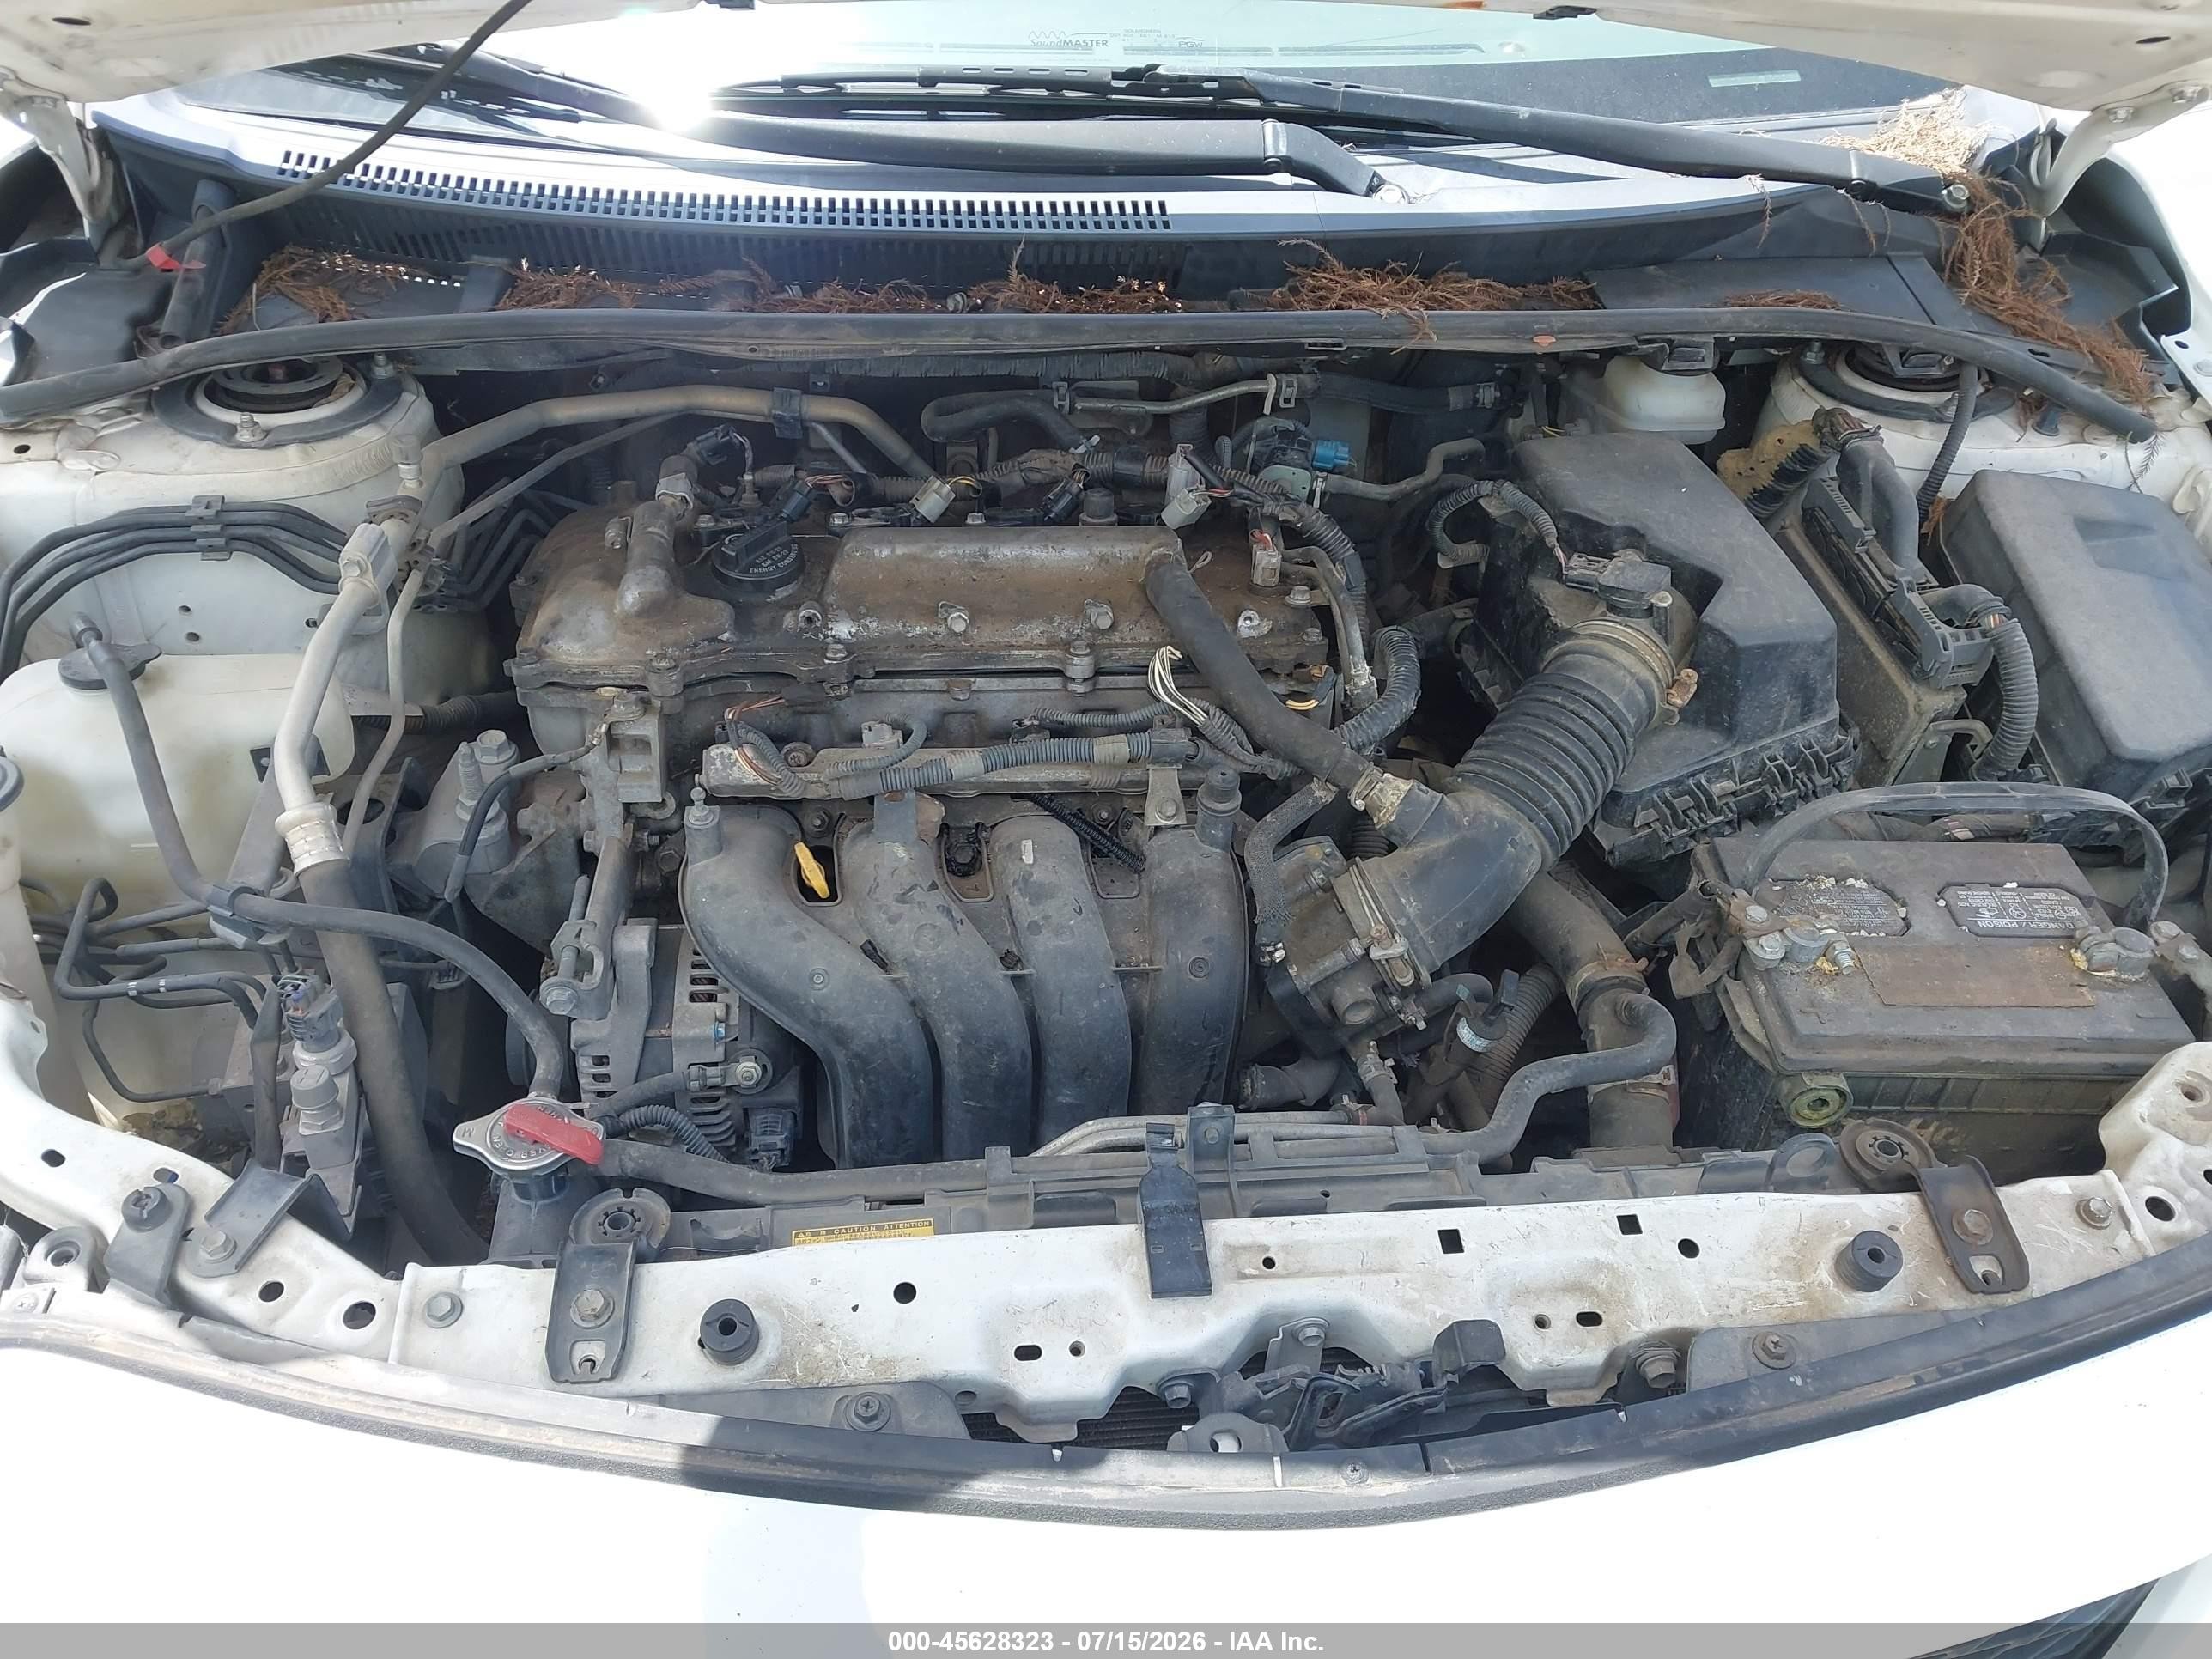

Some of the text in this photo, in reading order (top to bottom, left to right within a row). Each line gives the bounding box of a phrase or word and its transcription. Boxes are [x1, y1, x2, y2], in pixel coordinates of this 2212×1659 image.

[749, 565, 776, 574] ENERGY
[1978, 920, 2020, 928] POISON
[2030, 921, 2075, 929] DANGER
[833, 1225, 876, 1234] CAUTION
[884, 1220, 929, 1231] ATTENTION
